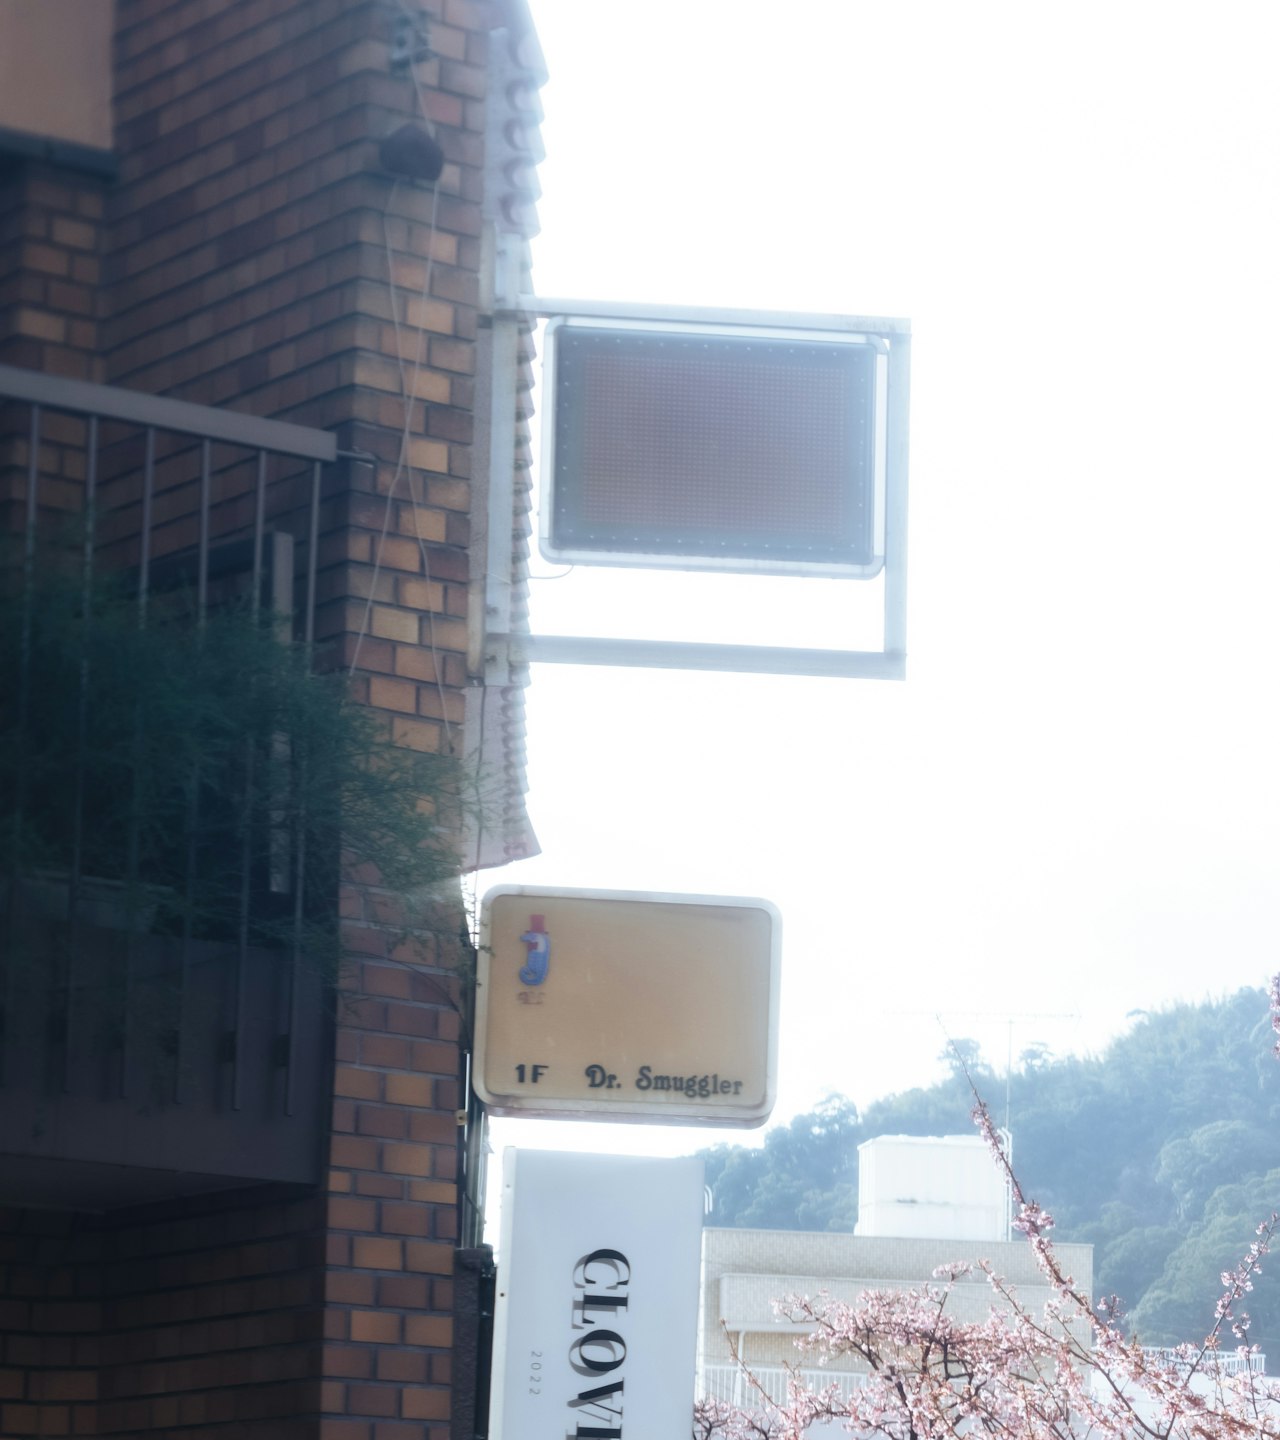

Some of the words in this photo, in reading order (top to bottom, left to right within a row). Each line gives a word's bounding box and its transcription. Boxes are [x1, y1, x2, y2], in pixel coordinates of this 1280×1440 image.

[515, 1064, 549, 1083] 1F
[585, 1064, 621, 1089] Dr.
[635, 1066, 743, 1098] Smuggler
[528, 1350, 542, 1397] 2022
